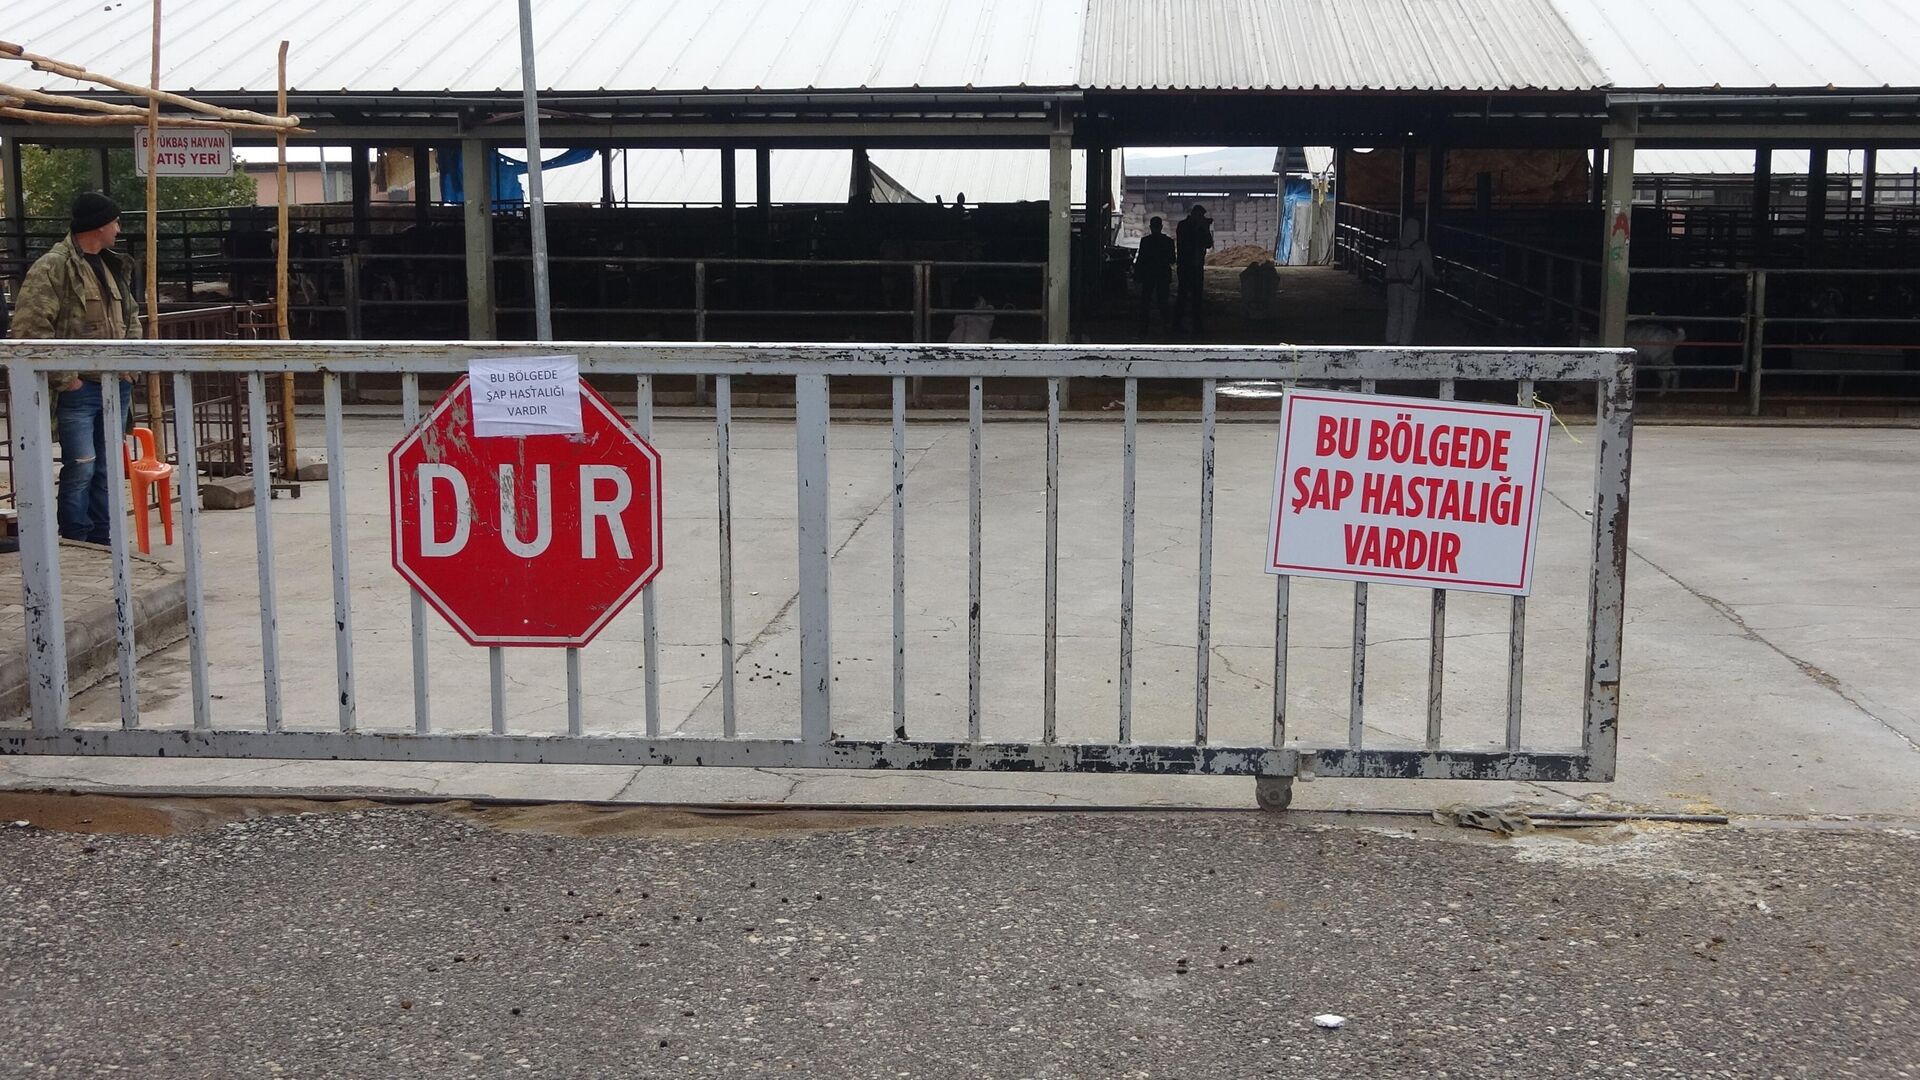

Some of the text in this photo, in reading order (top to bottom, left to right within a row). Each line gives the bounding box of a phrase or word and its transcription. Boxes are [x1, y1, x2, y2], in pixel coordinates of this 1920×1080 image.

[142, 135, 225, 151] BÜKBAŞ HAYVAN
[156, 150, 221, 168] ATIŞ YERİ
[490, 370, 558, 383] BU BÖLGEDE
[486, 385, 565, 402] ŞAP HASTALIĞI
[507, 405, 548, 416] VARDIR
[1315, 413, 1512, 472] BU BÖLGEDE
[1291, 466, 1523, 526] ŞAP HASTALIĞI
[418, 463, 633, 559] DUR
[1344, 524, 1461, 574] VARDIR
